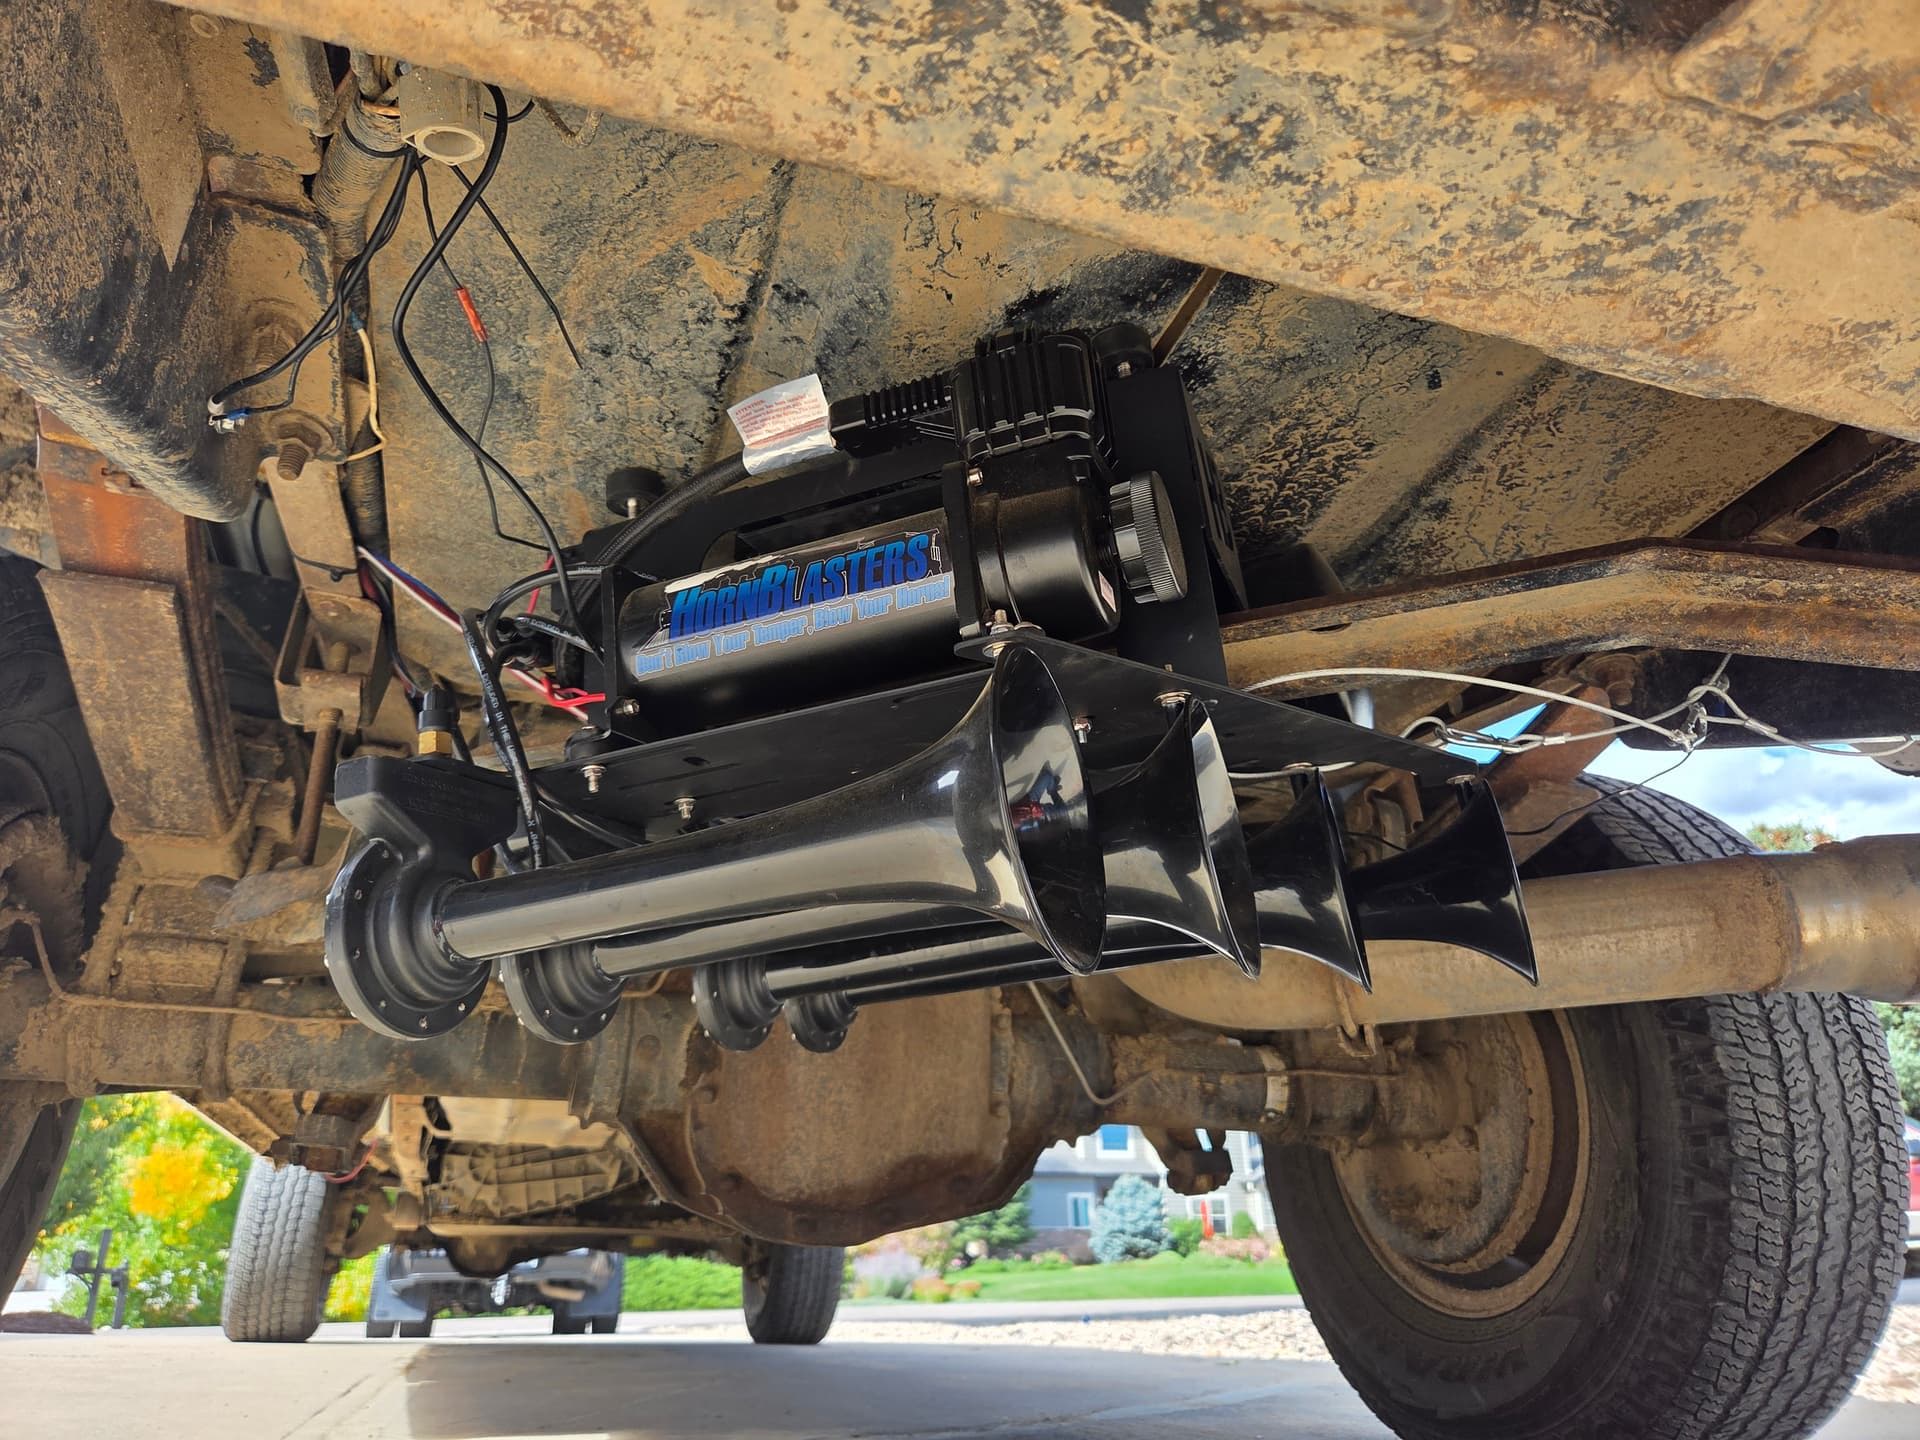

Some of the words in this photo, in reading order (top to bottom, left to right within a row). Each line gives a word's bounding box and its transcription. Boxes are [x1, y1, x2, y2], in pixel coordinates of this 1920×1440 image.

[674, 640, 711, 666] Blow
[712, 631, 750, 656] Your
[814, 604, 853, 631] Blow
[856, 593, 893, 620] Your
